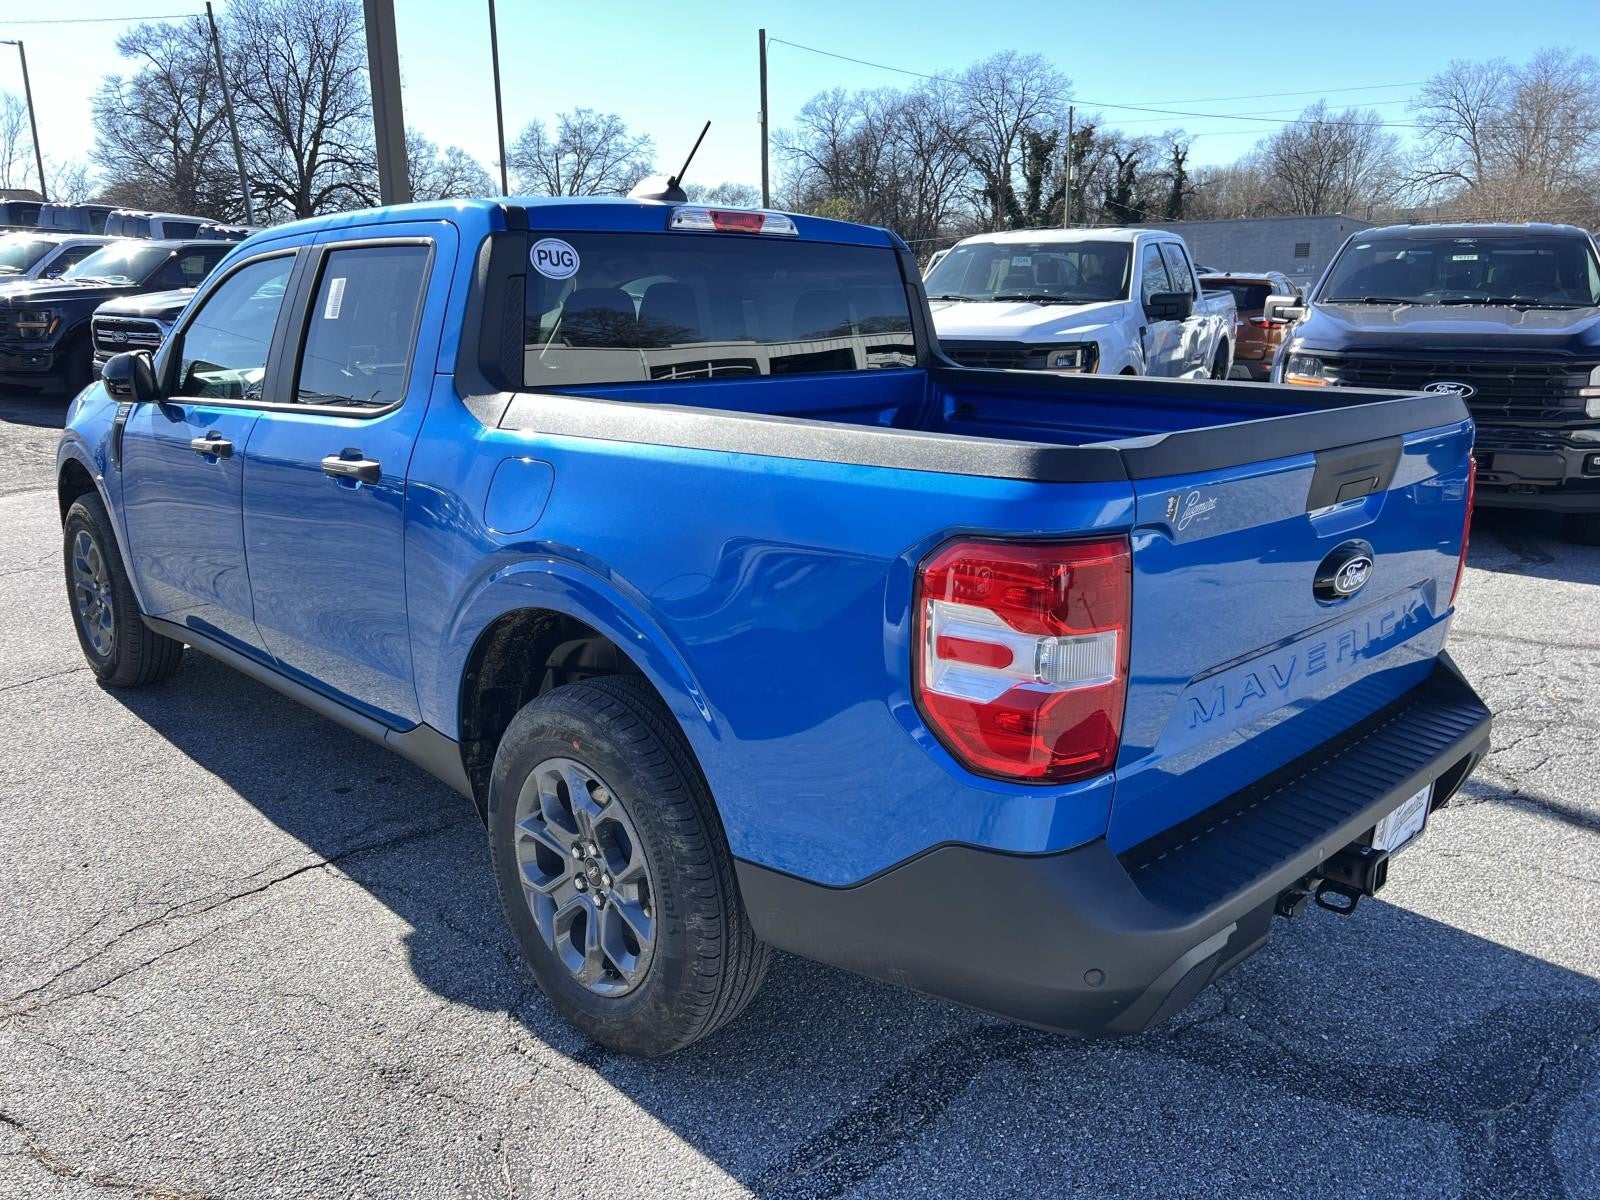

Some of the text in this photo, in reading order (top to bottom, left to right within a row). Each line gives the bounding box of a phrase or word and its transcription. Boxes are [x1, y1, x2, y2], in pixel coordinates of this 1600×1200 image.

[536, 249, 574, 267] PUG
[1341, 560, 1369, 589] Ford
[1188, 600, 1418, 729] MAVERICK
